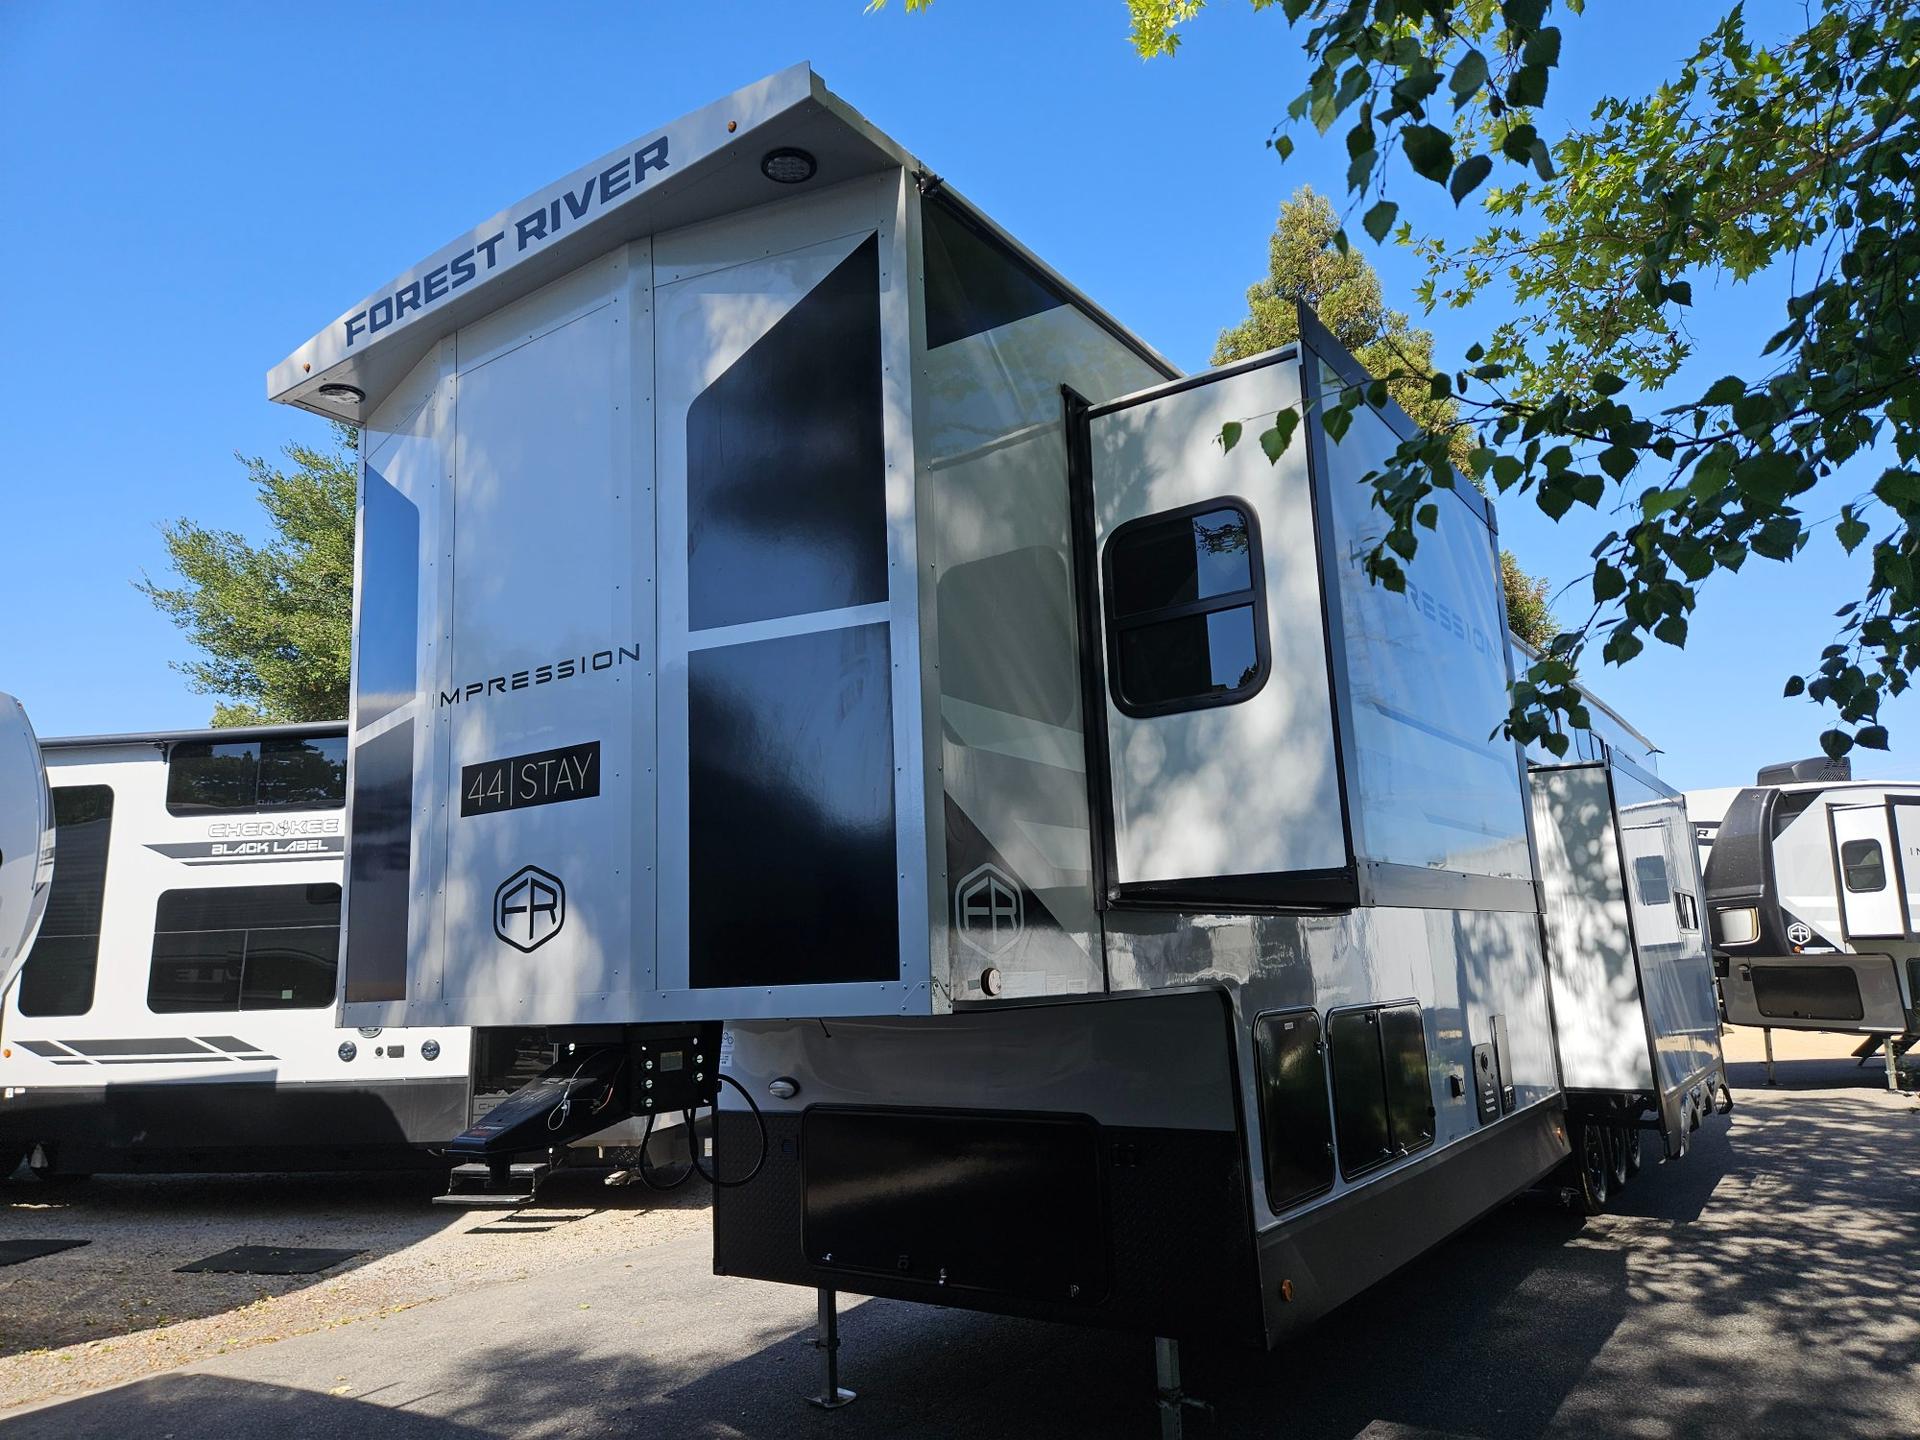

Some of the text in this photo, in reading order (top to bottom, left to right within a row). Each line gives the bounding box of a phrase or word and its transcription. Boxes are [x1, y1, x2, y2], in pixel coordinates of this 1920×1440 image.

[343, 135, 670, 348] FOREST RIVER
[211, 839, 329, 855] BLACK LABEL
